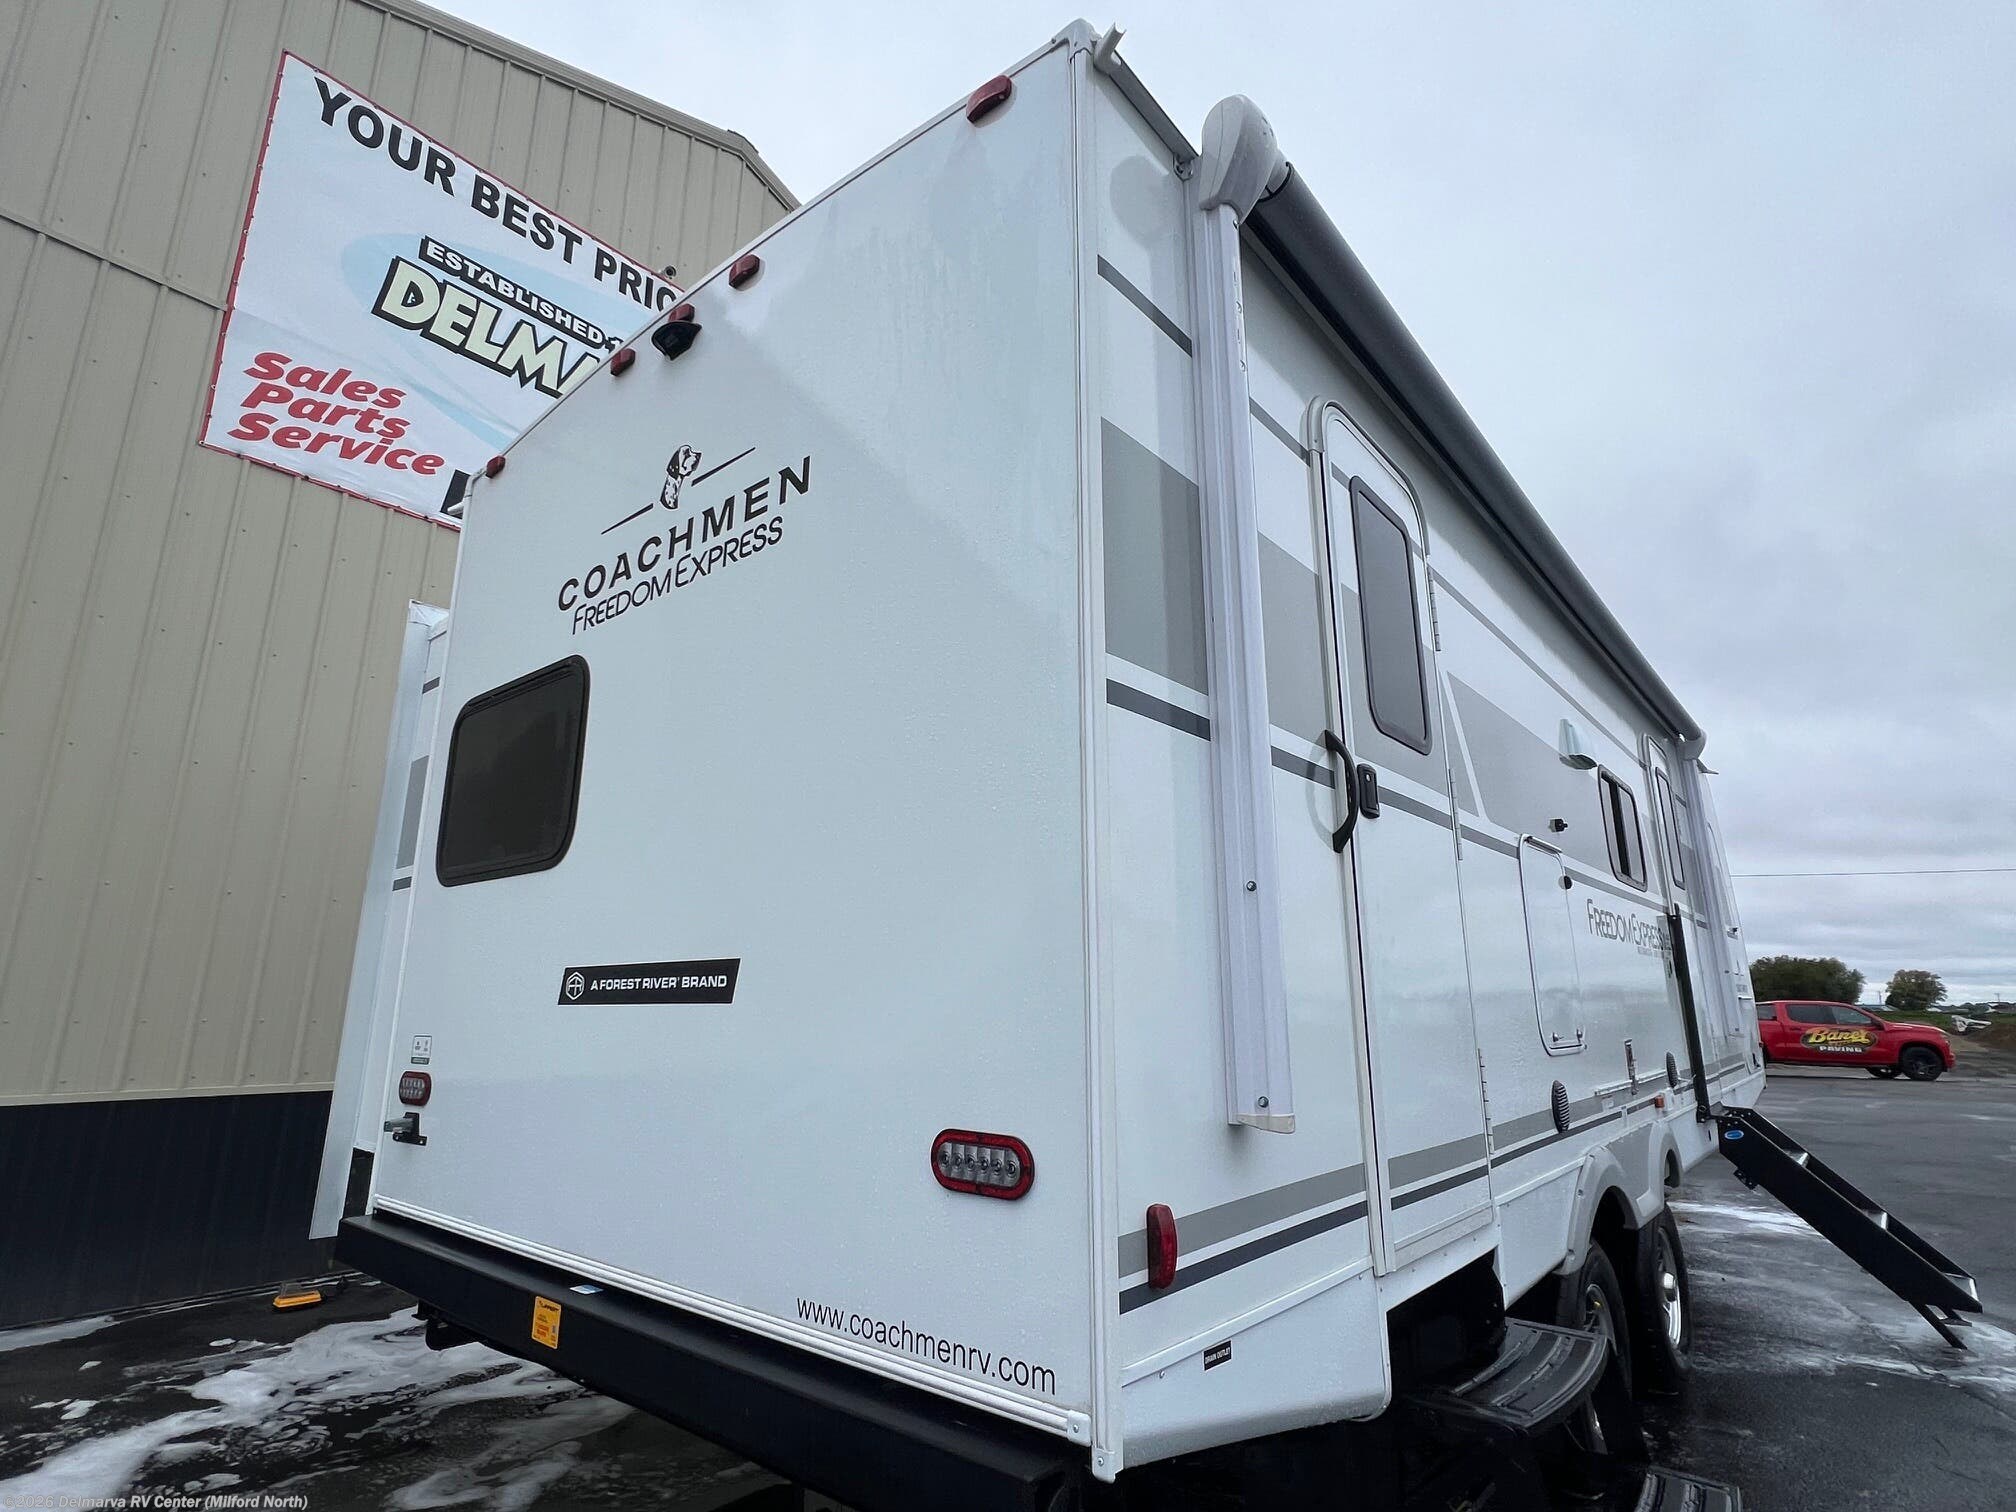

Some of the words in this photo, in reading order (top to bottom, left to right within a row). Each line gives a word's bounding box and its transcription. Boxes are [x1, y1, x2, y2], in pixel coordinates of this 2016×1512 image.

[313, 76, 456, 197] YOUR
[470, 173, 583, 265] BEST
[424, 239, 605, 346] ESTABLISHED
[239, 381, 411, 439] Parts
[242, 351, 408, 409] Sales
[226, 412, 445, 476] Service
[558, 455, 811, 612] COACHMEN
[590, 979, 599, 991] A
[599, 978, 642, 991] FOREST
[681, 974, 728, 988] BRAND
[796, 1297, 1056, 1396] www.coachmenrv.com
